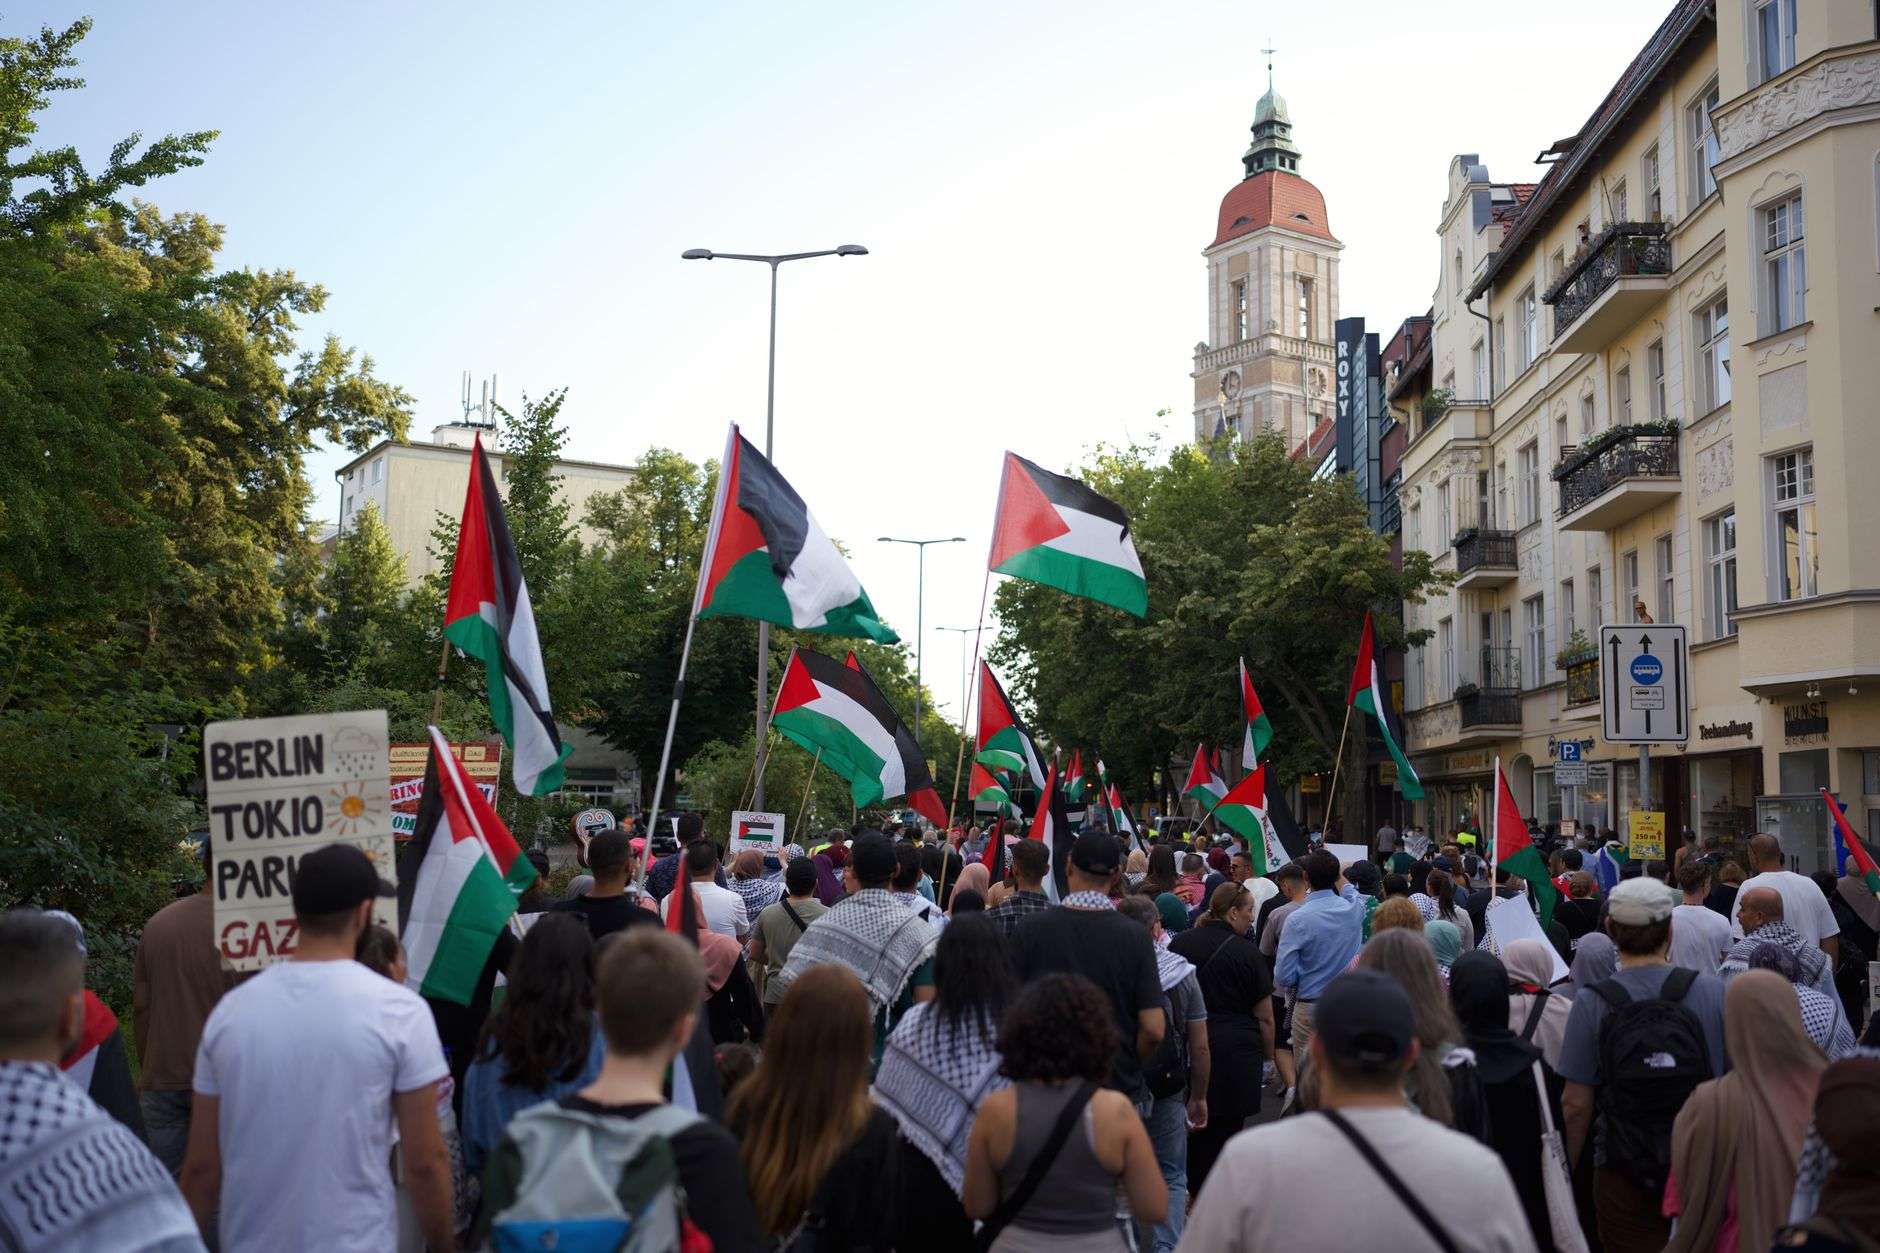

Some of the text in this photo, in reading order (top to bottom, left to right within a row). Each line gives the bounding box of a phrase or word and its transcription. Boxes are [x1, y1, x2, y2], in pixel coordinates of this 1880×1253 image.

[1338, 341, 1349, 416] ROXY
[1699, 720, 1753, 740] Teehandlung
[1784, 702, 1827, 719] KUNST
[210, 733, 324, 782] BERLIN
[1563, 744, 1575, 760] P
[211, 795, 323, 842] TOKIO
[217, 856, 297, 900] PARI
[221, 918, 300, 959] GAZ
